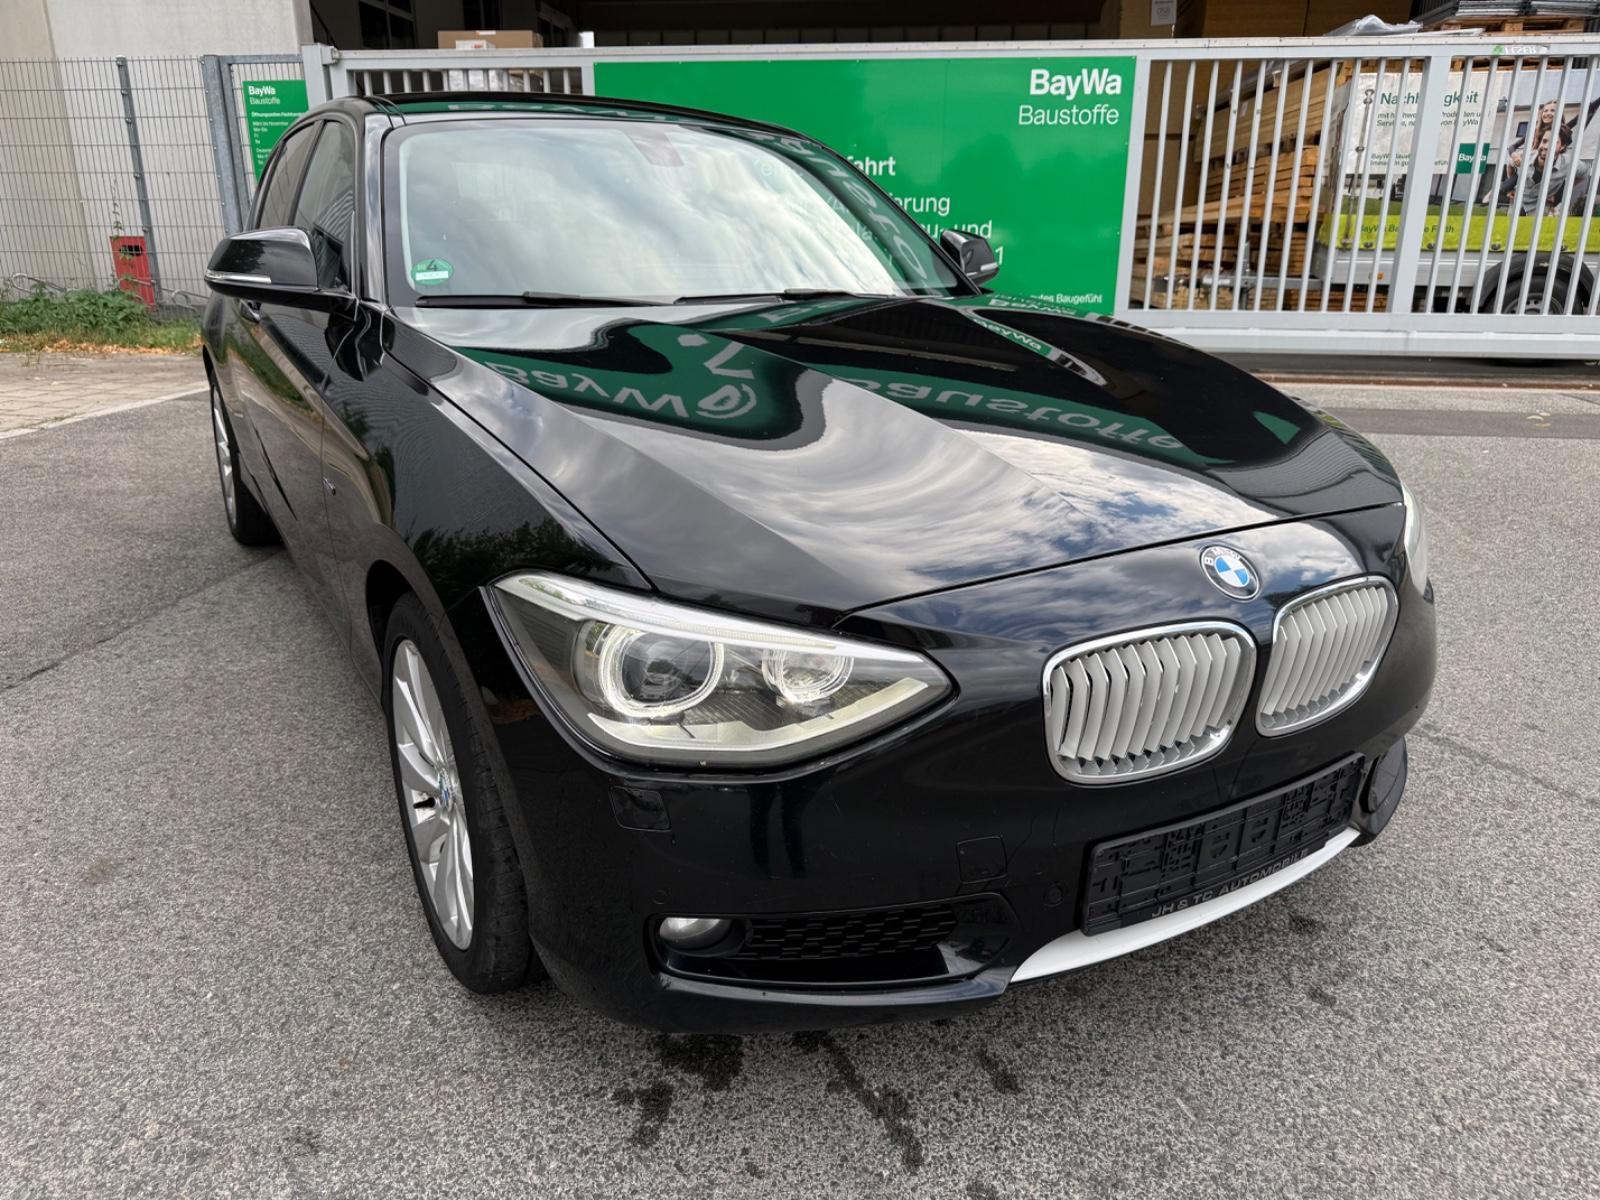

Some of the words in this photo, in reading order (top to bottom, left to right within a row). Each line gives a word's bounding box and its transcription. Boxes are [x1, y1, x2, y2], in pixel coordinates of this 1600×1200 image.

[1029, 68, 1122, 101] BayWa
[248, 86, 276, 97] BayWa
[249, 97, 281, 105] Baustoffe
[1018, 103, 1120, 126] Baustoffe
[1458, 152, 1487, 163] Baya
[1056, 293, 1103, 304] Baugefühl
